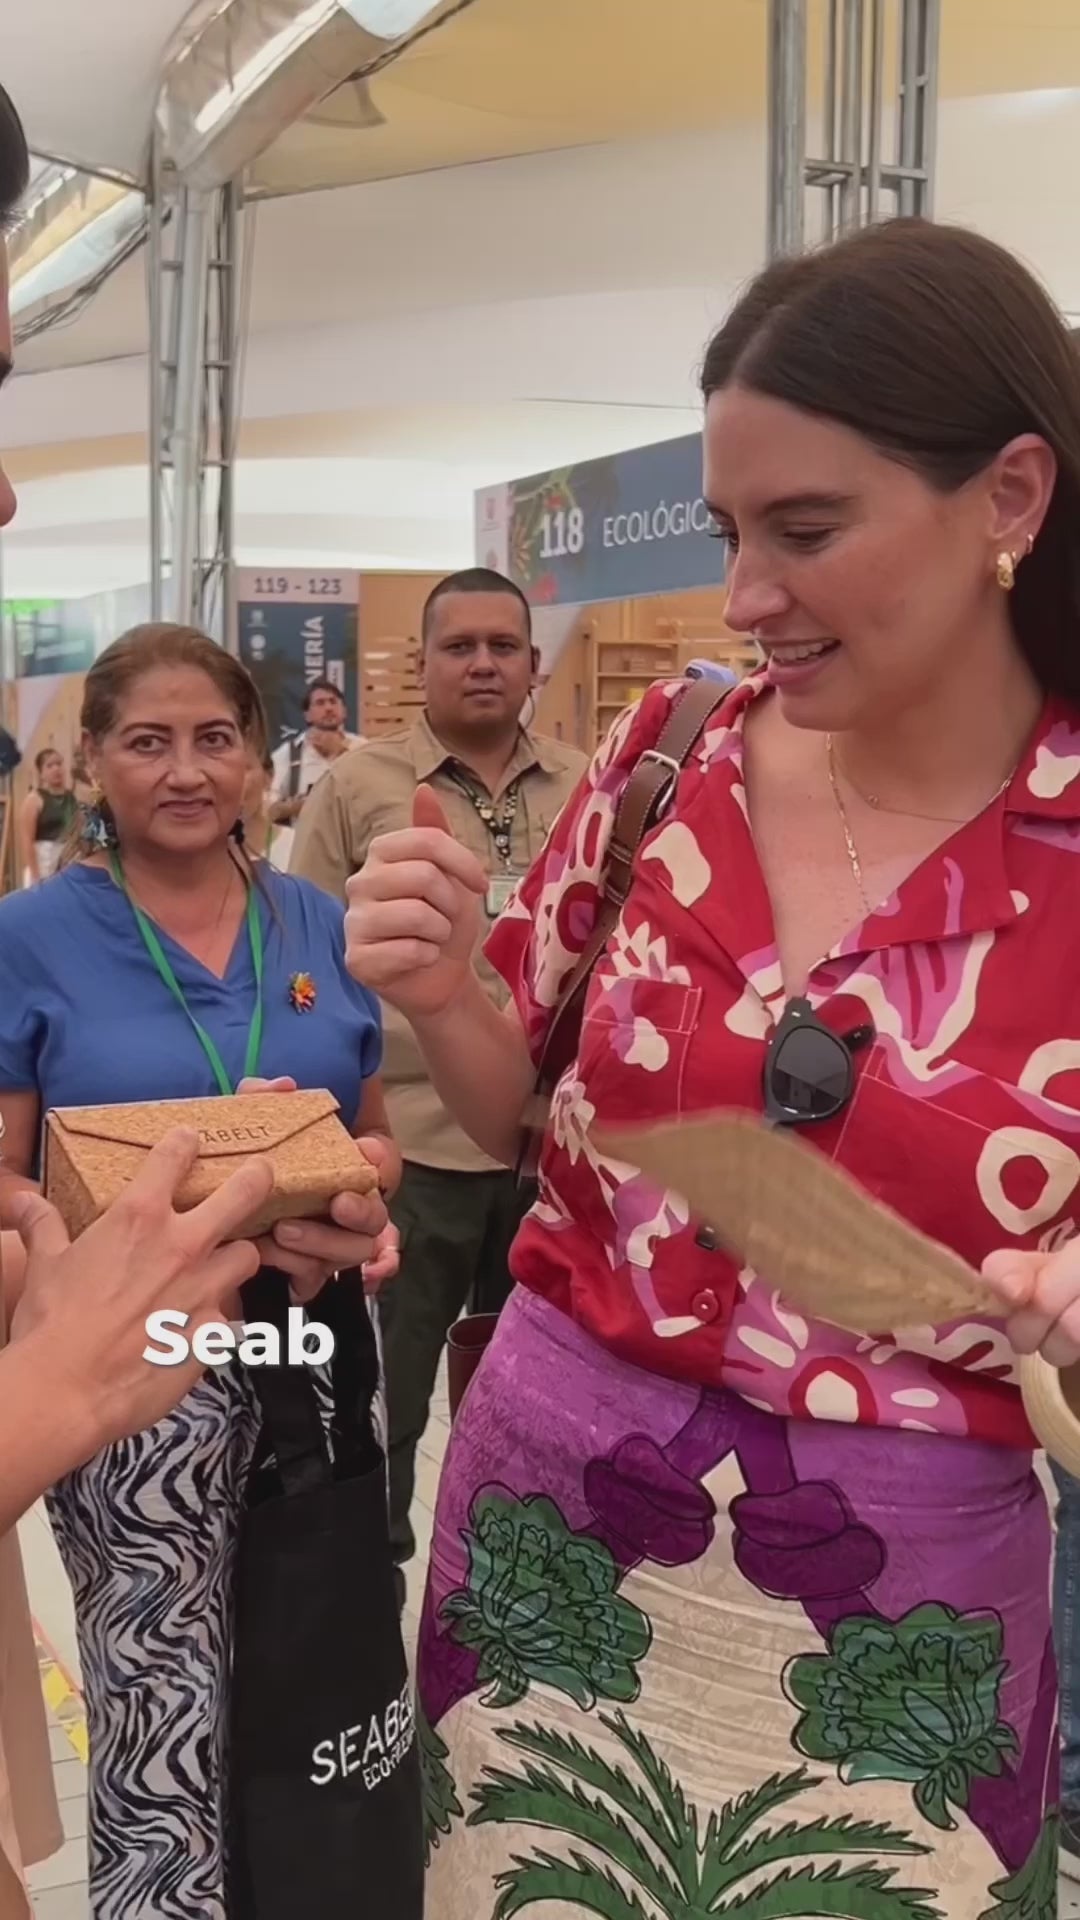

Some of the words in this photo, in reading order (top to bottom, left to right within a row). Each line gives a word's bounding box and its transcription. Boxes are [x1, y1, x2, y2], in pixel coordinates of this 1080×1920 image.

[540, 507, 585, 558] 118
[254, 577, 288, 594] 119
[308, 578, 342, 595] 123
[300, 615, 324, 685] NERÍA
[198, 1125, 270, 1143] ABELT
